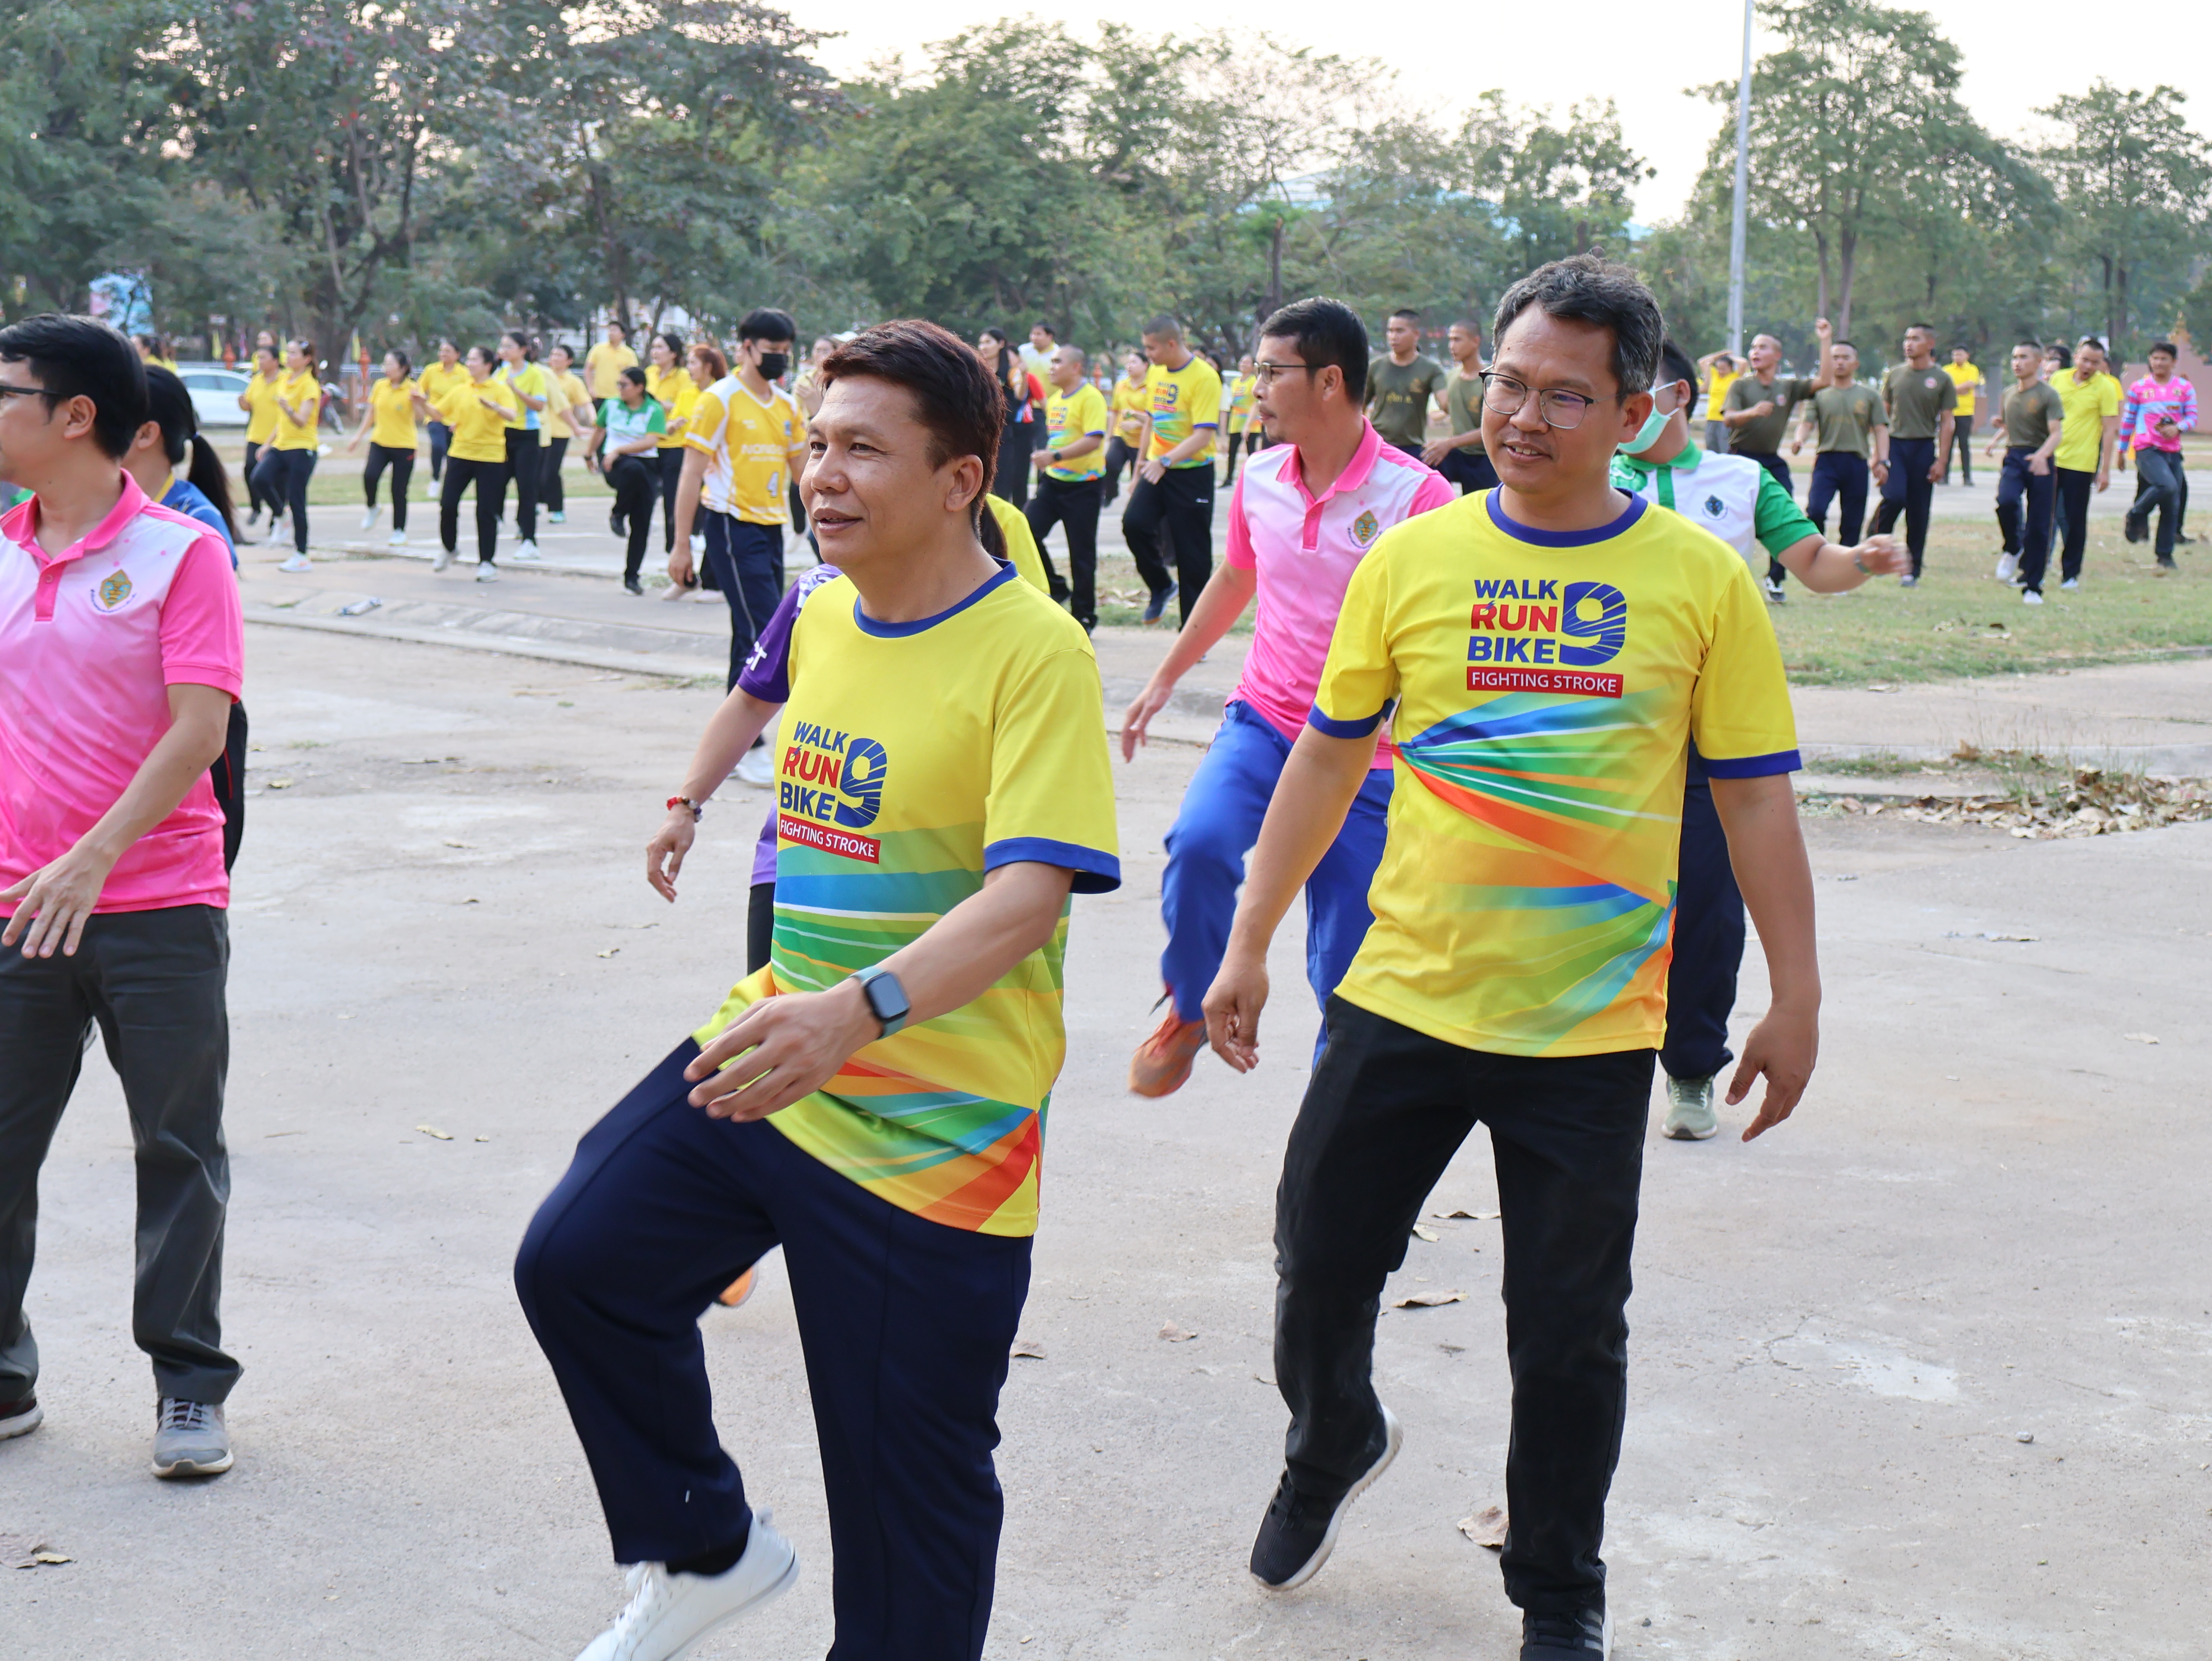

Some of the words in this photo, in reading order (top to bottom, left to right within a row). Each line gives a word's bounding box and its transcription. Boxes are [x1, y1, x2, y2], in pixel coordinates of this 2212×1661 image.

[767, 472, 779, 498] 4
[1474, 580, 1559, 600] WALK
[1471, 603, 1558, 632] RUN
[1559, 581, 1627, 666] 9
[1467, 636, 1556, 664] BIKE
[1472, 672, 1549, 688] FIGHTING
[1554, 676, 1617, 693] STROKE
[793, 721, 849, 754] WALK
[782, 746, 842, 789] RUN
[834, 737, 888, 828] 9
[780, 781, 836, 821] BIKE
[780, 819, 824, 845] FIGHTING
[826, 833, 875, 858] STROKE
